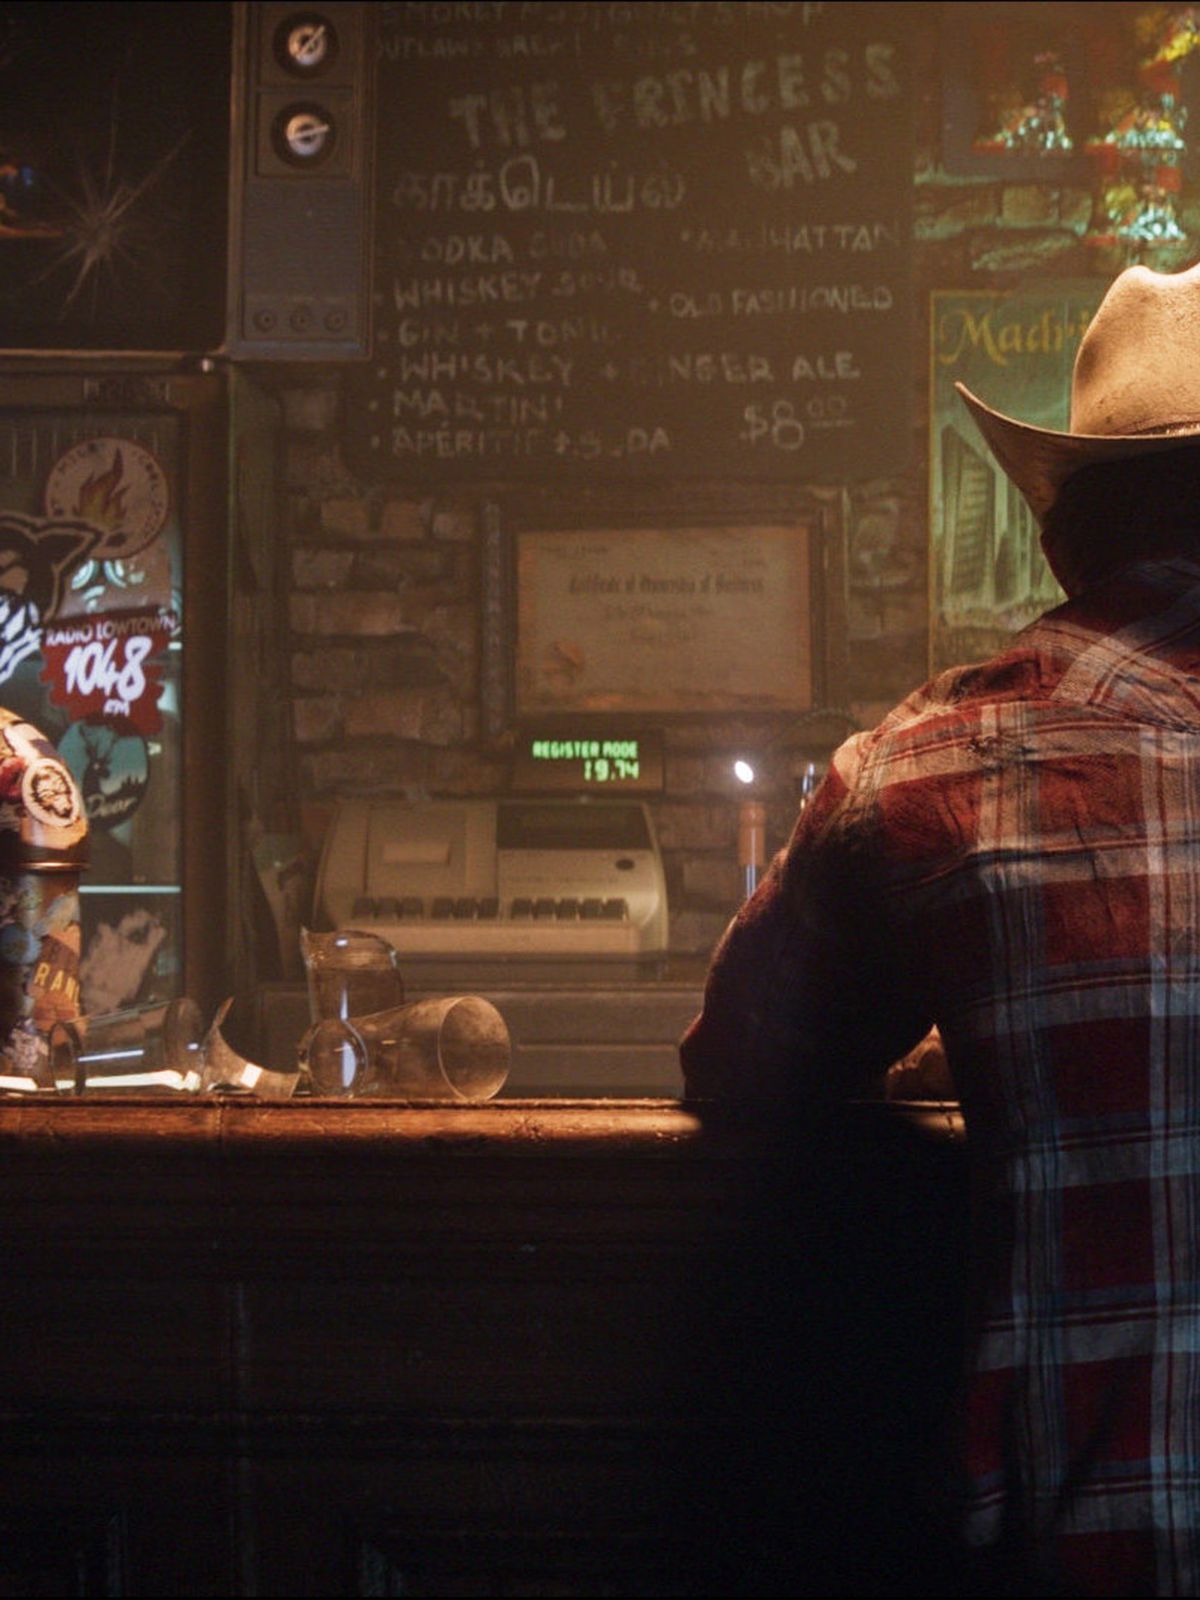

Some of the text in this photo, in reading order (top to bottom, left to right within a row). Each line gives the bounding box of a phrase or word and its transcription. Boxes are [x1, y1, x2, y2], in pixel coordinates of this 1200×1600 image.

[449, 82, 567, 148] THE
[745, 119, 857, 192] BAR
[394, 271, 543, 311] WHISKEY
[401, 352, 573, 386] WHISKEY
[792, 351, 861, 382] ALE
[46, 615, 176, 646] RADIO LOWTOWN
[532, 741, 638, 759] REGISTER MODE
